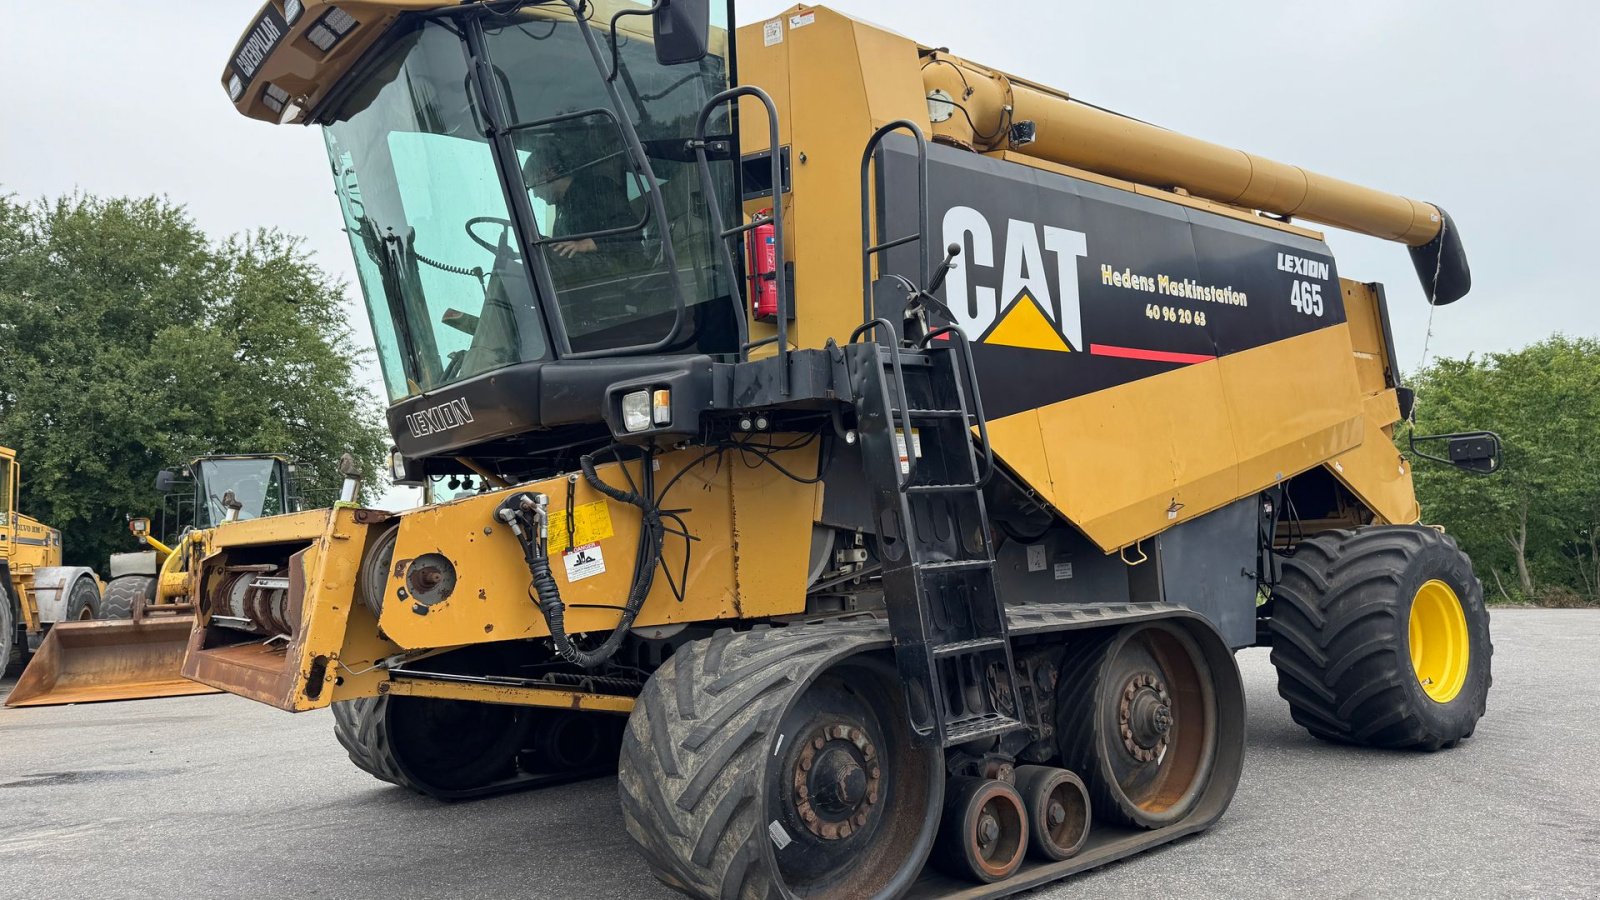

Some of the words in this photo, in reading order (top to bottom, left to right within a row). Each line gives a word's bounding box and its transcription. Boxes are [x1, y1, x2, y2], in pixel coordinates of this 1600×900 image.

[236, 15, 281, 77] CATERPILLAR
[942, 206, 1088, 352] CAT
[1101, 264, 1156, 293] Hedens
[1158, 274, 1248, 307] Maskinstation
[1277, 252, 1329, 281] LEXION
[1145, 304, 1160, 320] 40
[1162, 306, 1176, 323] 96
[1178, 308, 1192, 325] 20
[1194, 311, 1207, 327] 63
[1290, 280, 1324, 317] 465
[406, 397, 474, 438] LEXION
